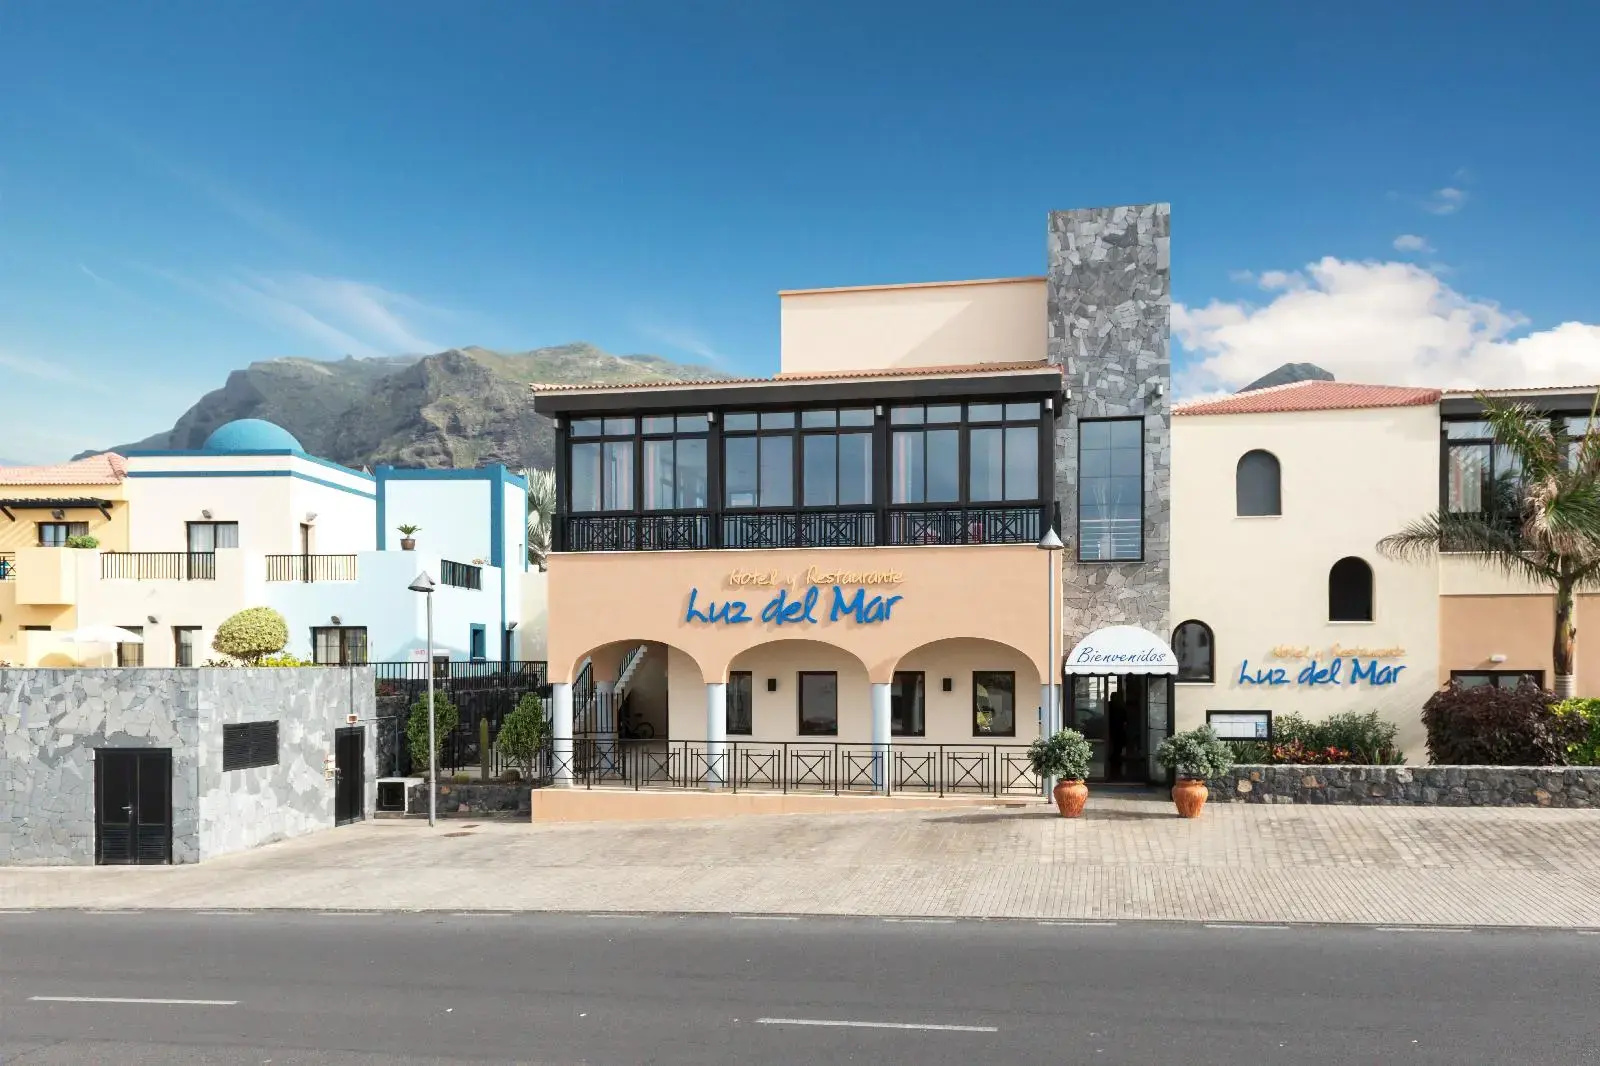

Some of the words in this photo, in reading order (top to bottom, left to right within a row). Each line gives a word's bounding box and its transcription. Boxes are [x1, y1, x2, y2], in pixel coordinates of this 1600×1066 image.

[729, 568, 778, 586] Hotel
[786, 573, 797, 592] y
[806, 565, 904, 585] Restaurante
[686, 587, 752, 624] Luz
[761, 585, 819, 625] del
[830, 585, 904, 624] Mar
[1077, 646, 1167, 663] Bienvenidos
[1238, 658, 1291, 685] Luz
[1297, 657, 1342, 686] del
[1351, 657, 1407, 686] Mar
